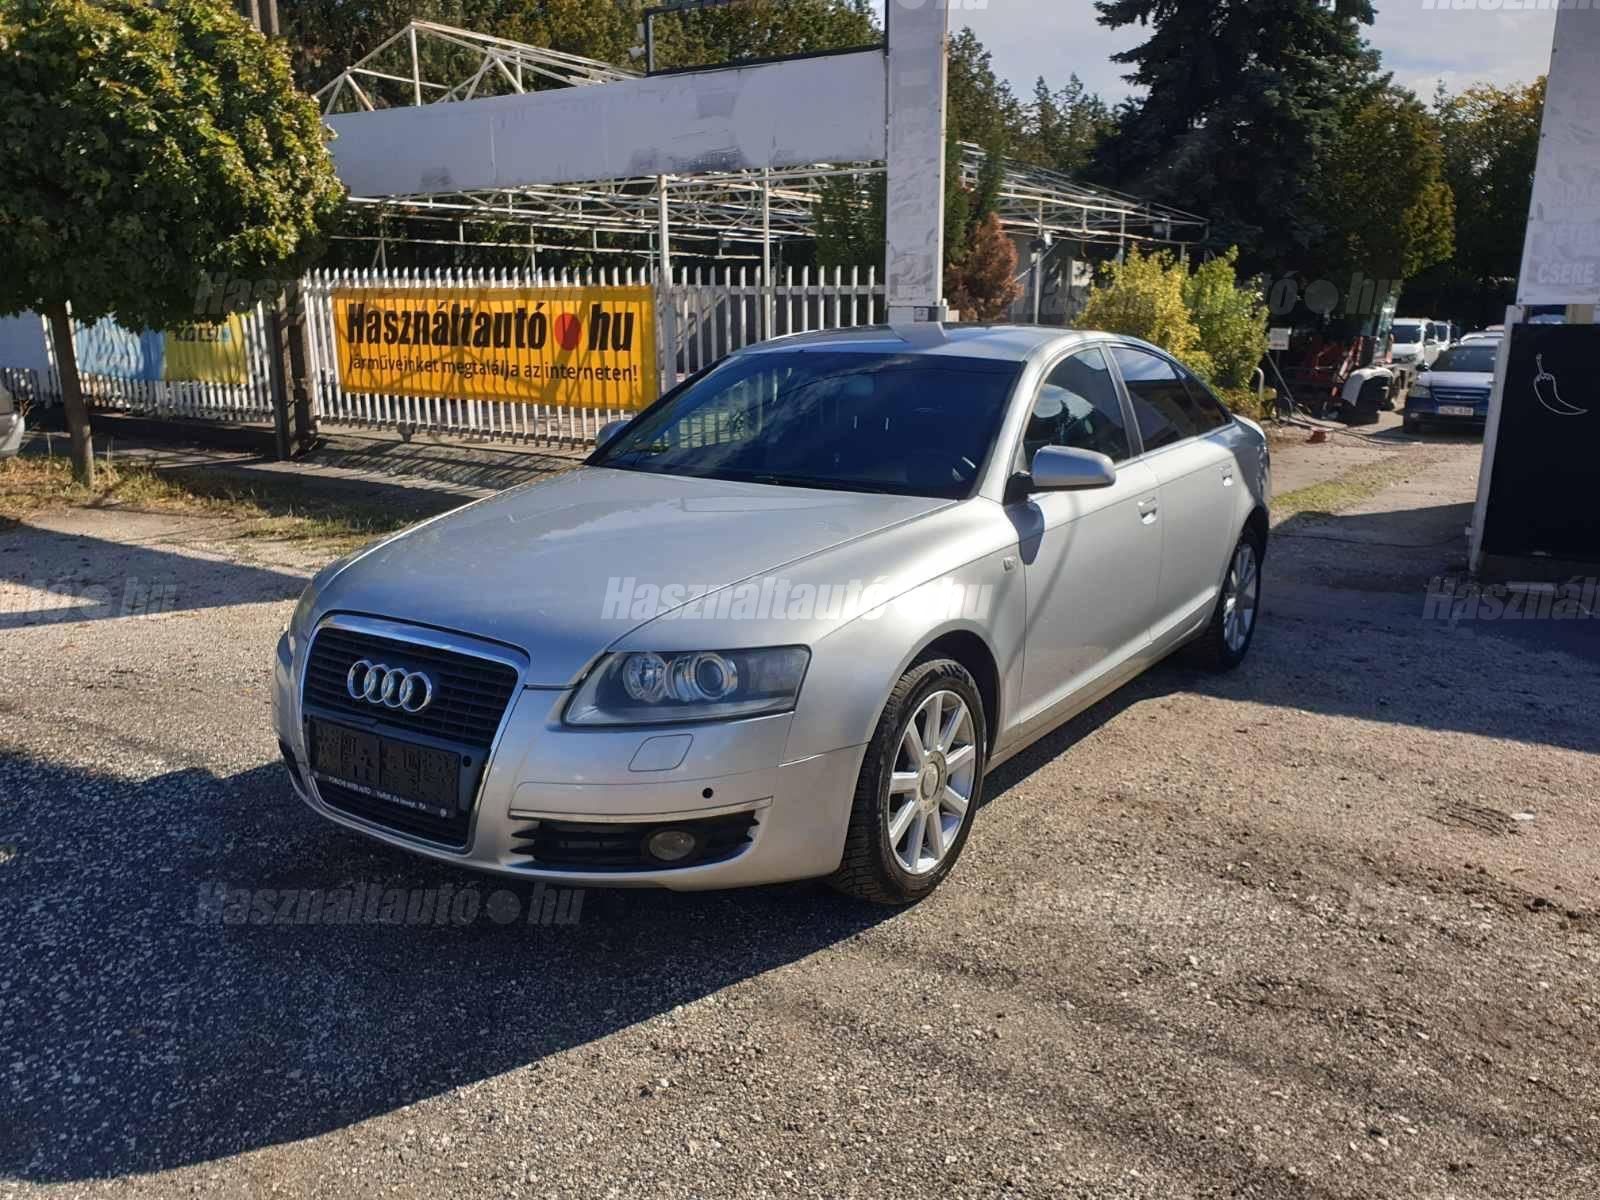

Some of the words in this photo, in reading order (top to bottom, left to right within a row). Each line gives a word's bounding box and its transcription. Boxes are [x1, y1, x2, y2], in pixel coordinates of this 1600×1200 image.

[348, 302, 547, 349] Használtautó
[441, 358, 519, 382] megtalálja
[524, 364, 541, 378] az
[545, 361, 638, 382] interneten!
